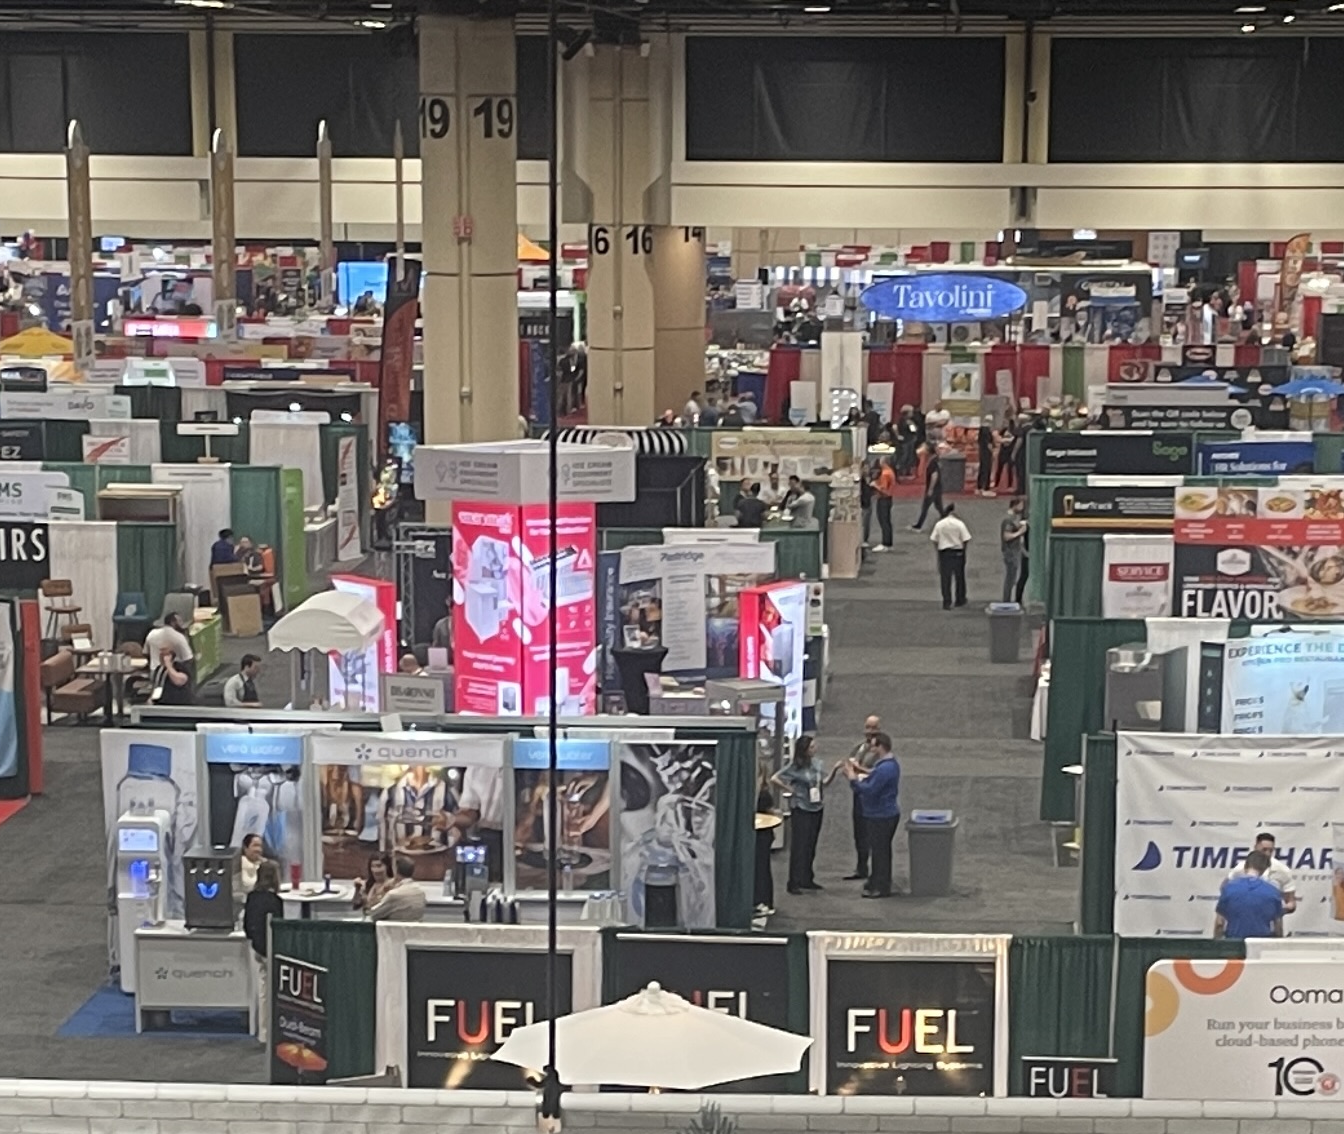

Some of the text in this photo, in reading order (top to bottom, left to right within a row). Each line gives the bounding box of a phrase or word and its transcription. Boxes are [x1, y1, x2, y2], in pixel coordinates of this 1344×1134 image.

[472, 97, 514, 139] 19
[626, 226, 654, 255] 16
[892, 284, 996, 310] Tavolini
[1153, 440, 1188, 461] Sage
[1116, 566, 1164, 578] SERVICE
[1228, 642, 1302, 659] EXPERIENCE
[1306, 641, 1334, 653] THE
[247, 742, 288, 756] water
[377, 743, 457, 762] quench
[172, 968, 234, 980] quench
[278, 964, 323, 1004] FUEL
[1269, 985, 1344, 1004] Ooma
[426, 999, 535, 1045] FUEL
[846, 1007, 975, 1055] FUEL
[1207, 1018, 1235, 1031] Run
[1238, 1019, 1270, 1034] your
[1273, 1017, 1333, 1031] business
[1215, 1034, 1299, 1047] cloud-based
[1030, 1066, 1107, 1098] FUEL
